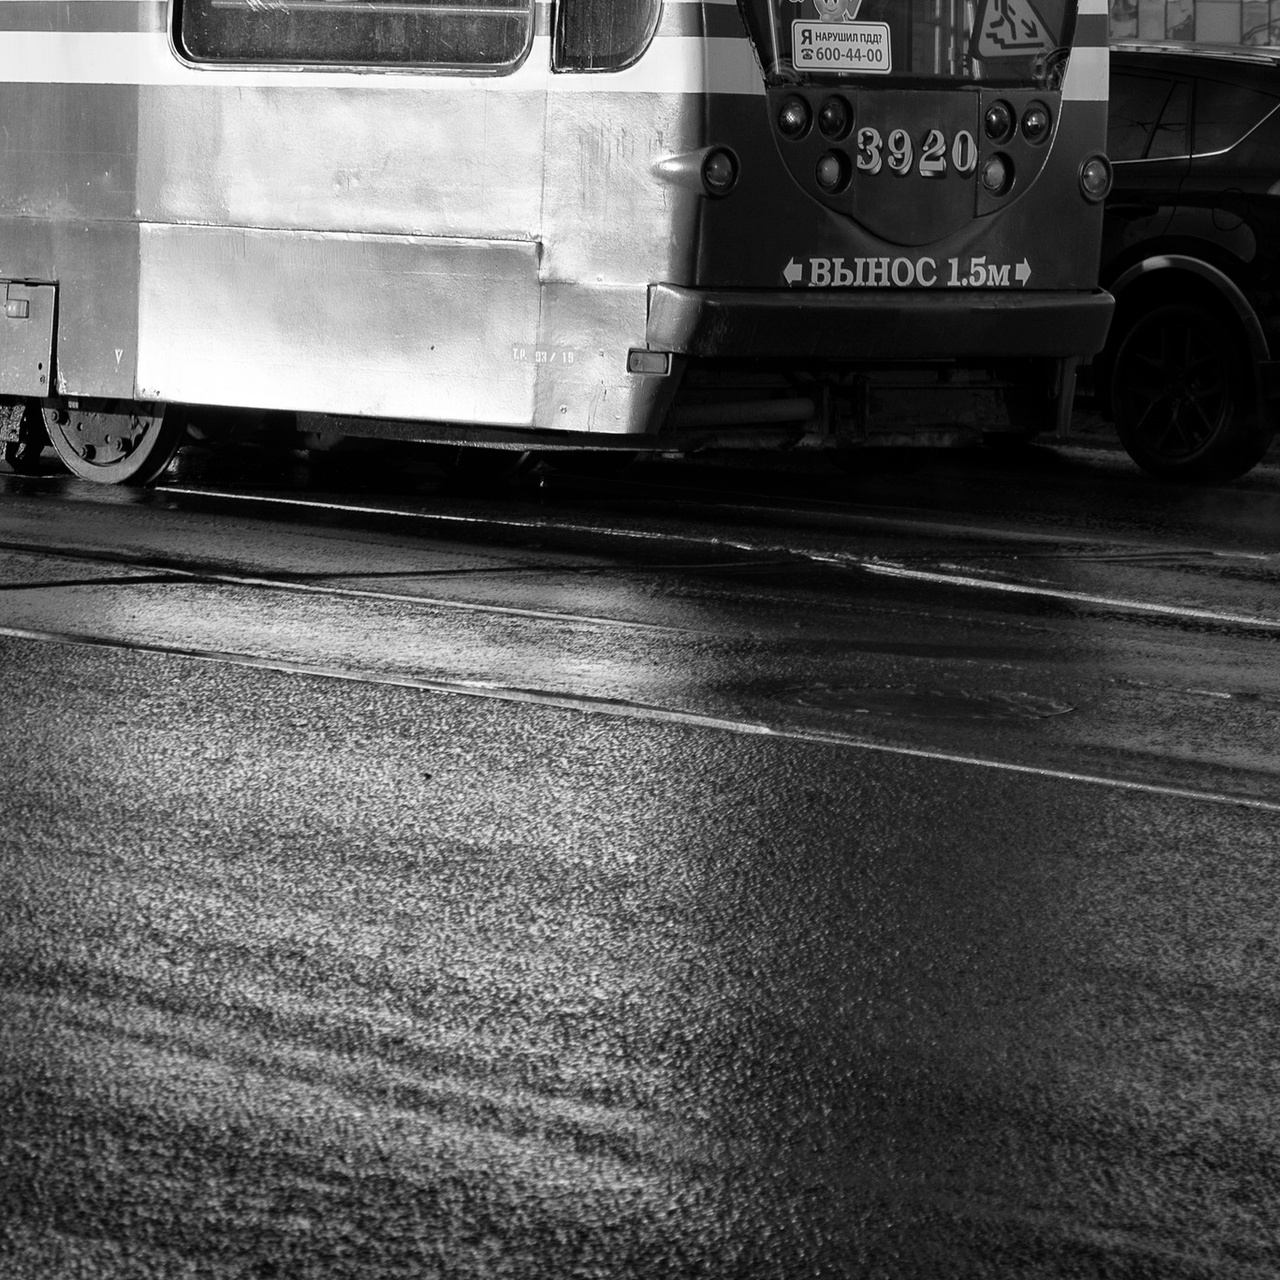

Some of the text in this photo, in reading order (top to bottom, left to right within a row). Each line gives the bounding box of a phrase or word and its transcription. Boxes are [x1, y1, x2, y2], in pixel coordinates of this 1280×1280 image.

[801, 29, 882, 45] Я НАРУШИЛ ПДД?
[816, 47, 883, 62] 600-44-00
[855, 126, 979, 177] 3920
[808, 257, 936, 287] ВЫНОС
